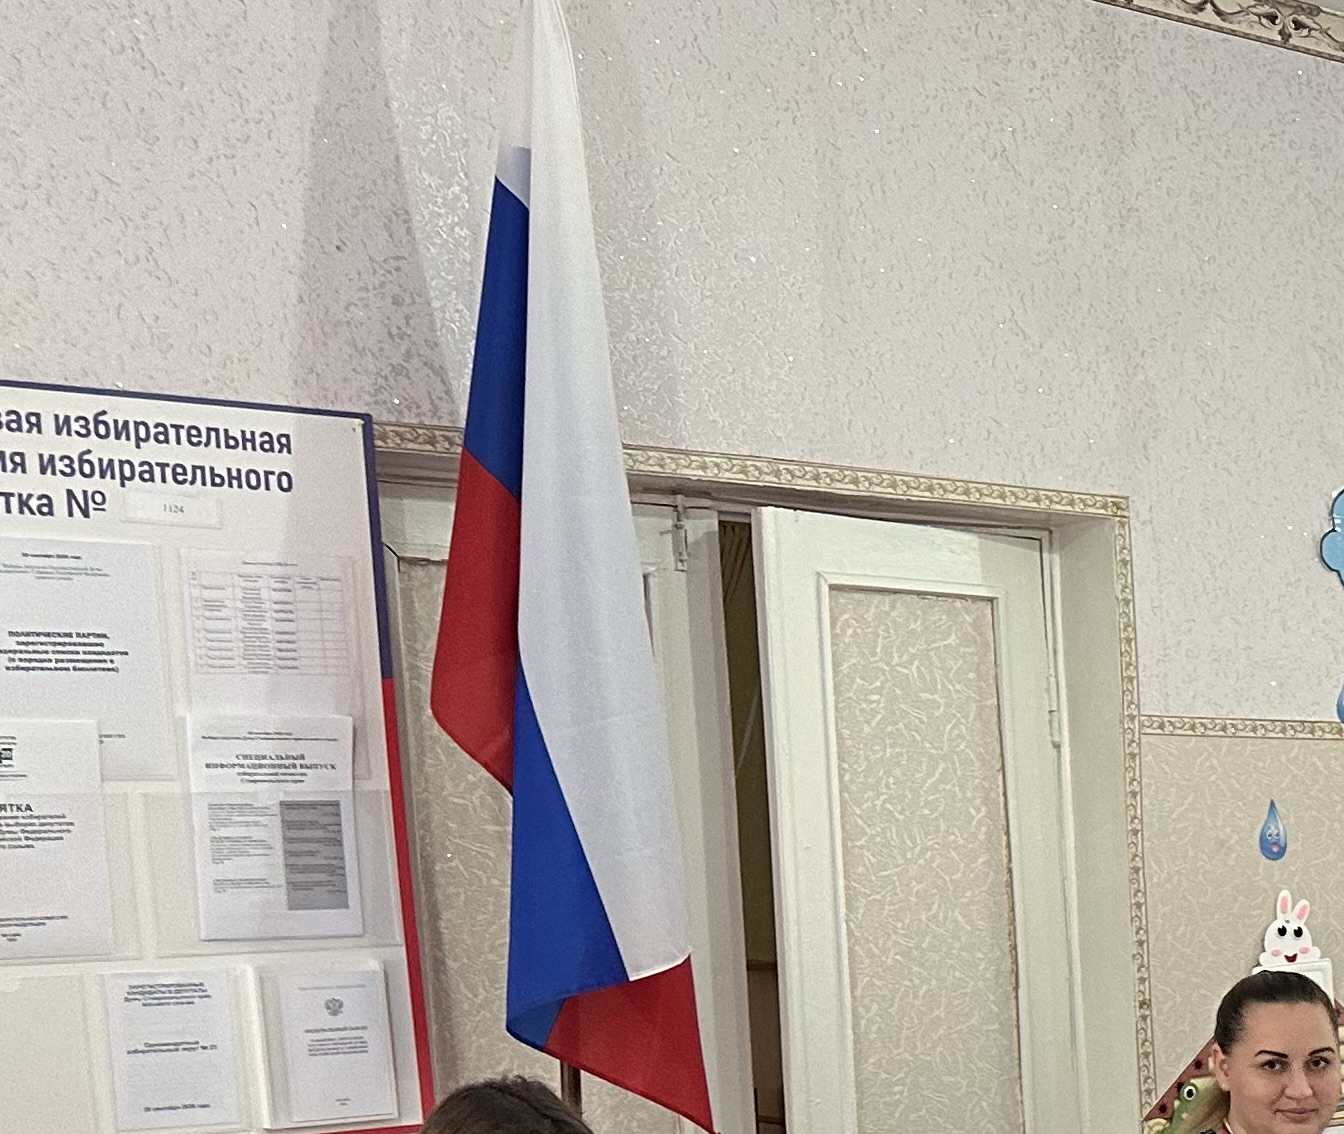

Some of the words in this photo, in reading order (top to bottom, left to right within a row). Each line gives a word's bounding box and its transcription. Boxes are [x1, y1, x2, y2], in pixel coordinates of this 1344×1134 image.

[0, 409, 43, 435] ая
[53, 409, 292, 454] избирательная
[38, 448, 293, 493] избирательного
[66, 488, 107, 519] №
